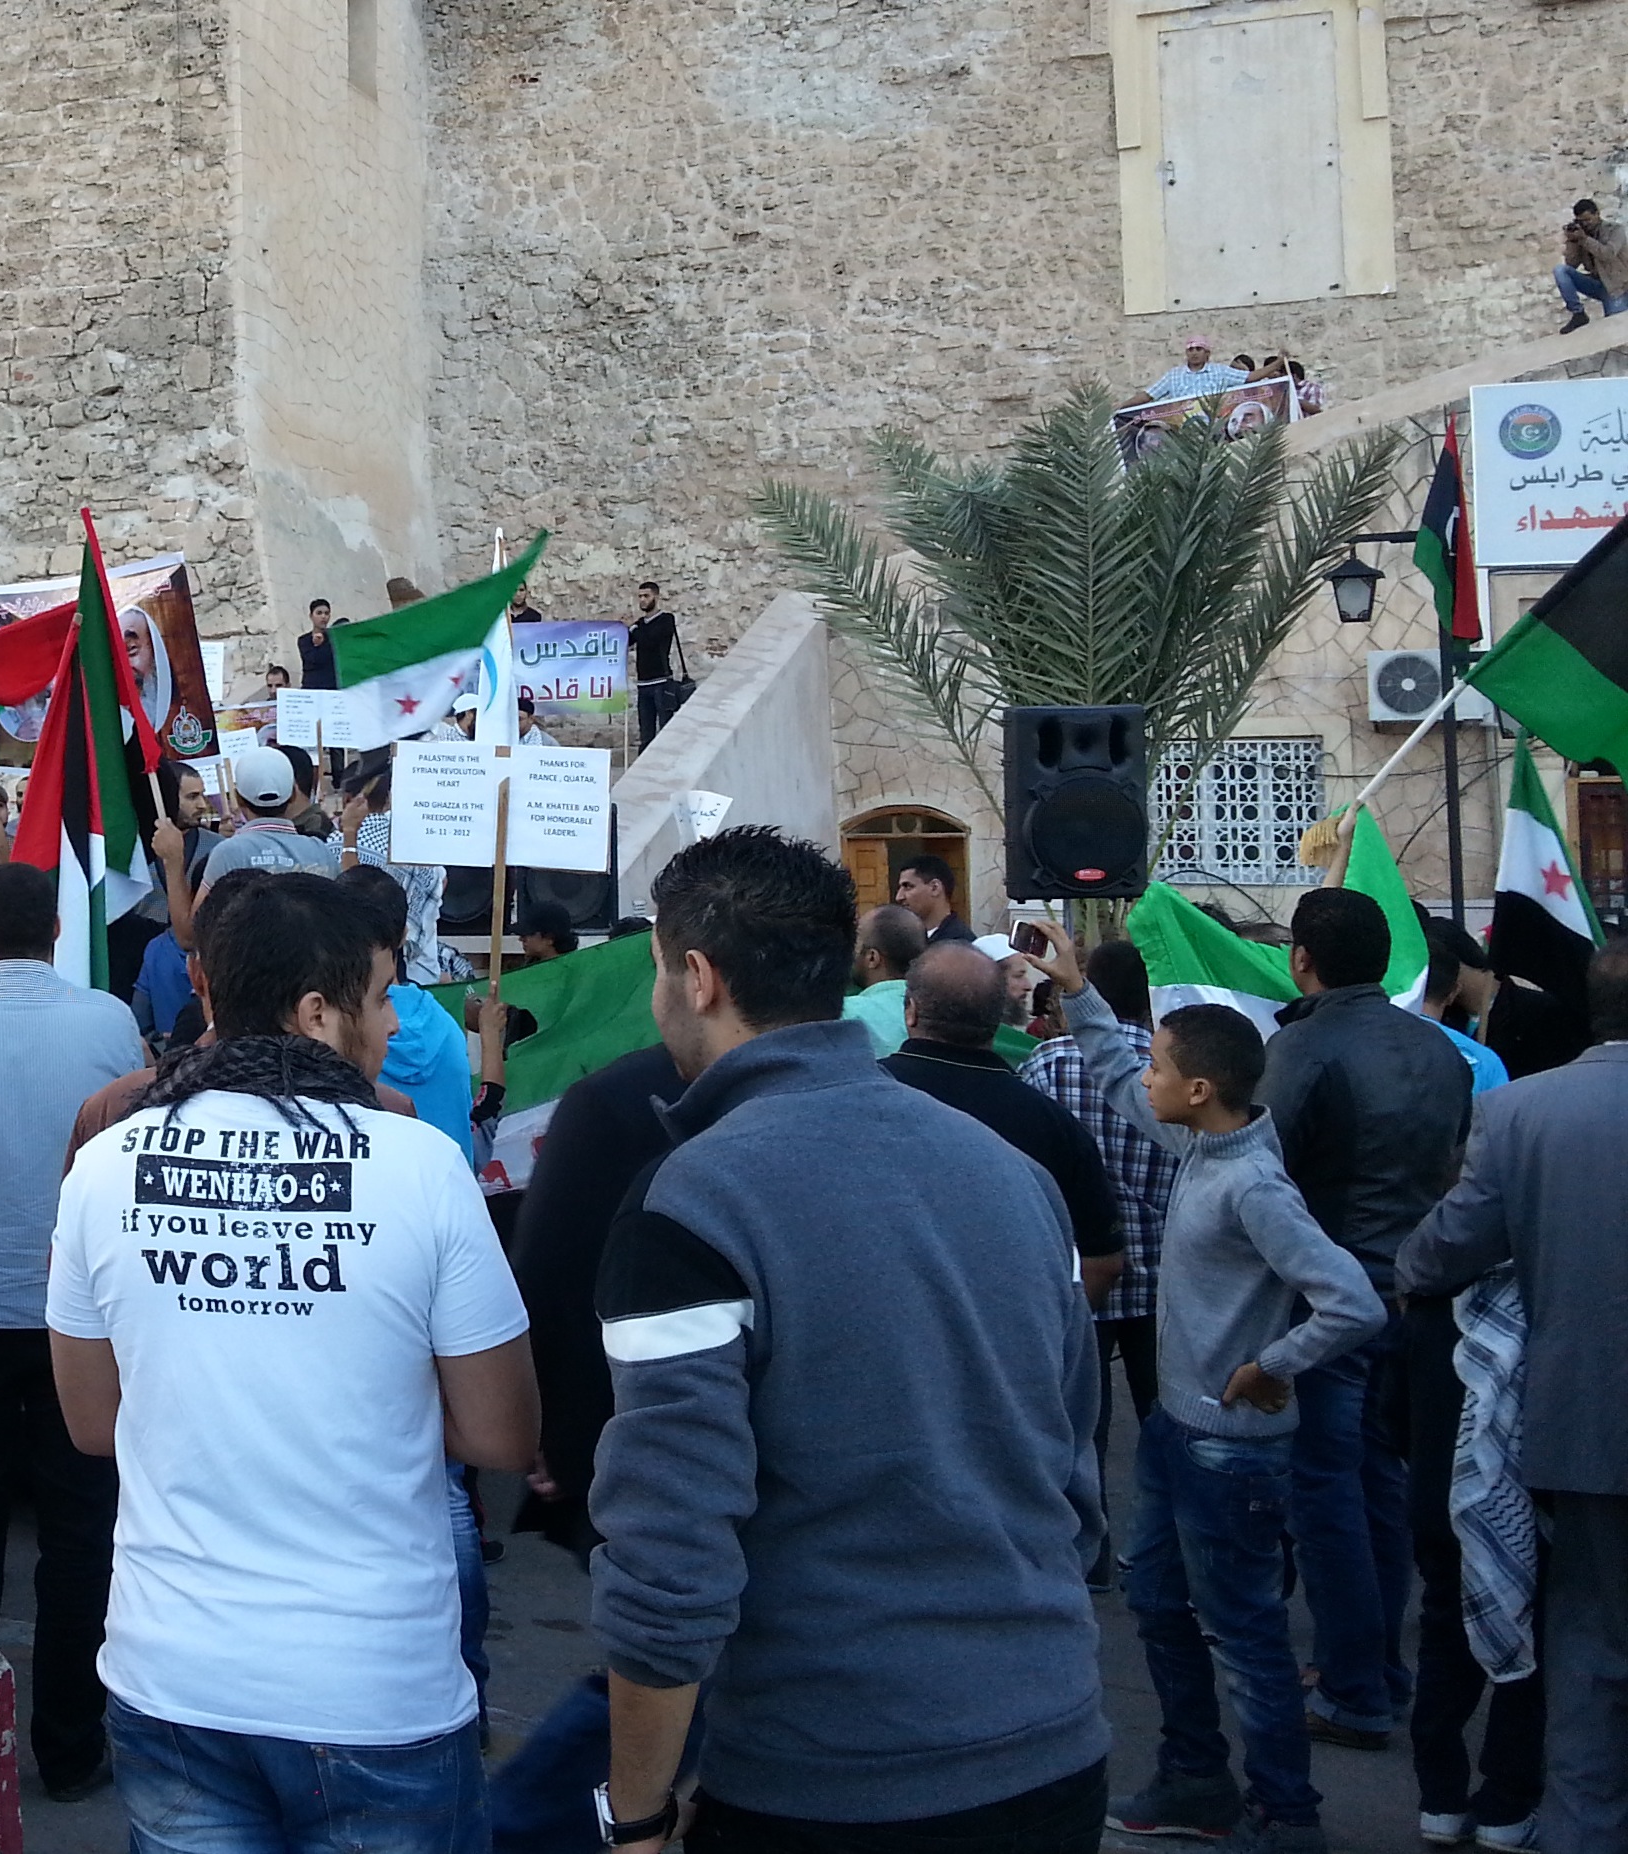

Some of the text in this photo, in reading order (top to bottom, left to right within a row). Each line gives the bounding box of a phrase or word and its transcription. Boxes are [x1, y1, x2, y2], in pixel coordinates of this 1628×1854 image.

[1510, 463, 1604, 490] طرابلس
[520, 631, 619, 666] ياقدس
[518, 677, 579, 700] قادم
[547, 816, 592, 824] HONORABLE
[121, 1125, 371, 1160] STOP THE WAR
[160, 1165, 326, 1204] WENHAO-6
[121, 1208, 377, 1246] if you leave my
[141, 1243, 346, 1292] world
[178, 1292, 314, 1316] tomorrow
